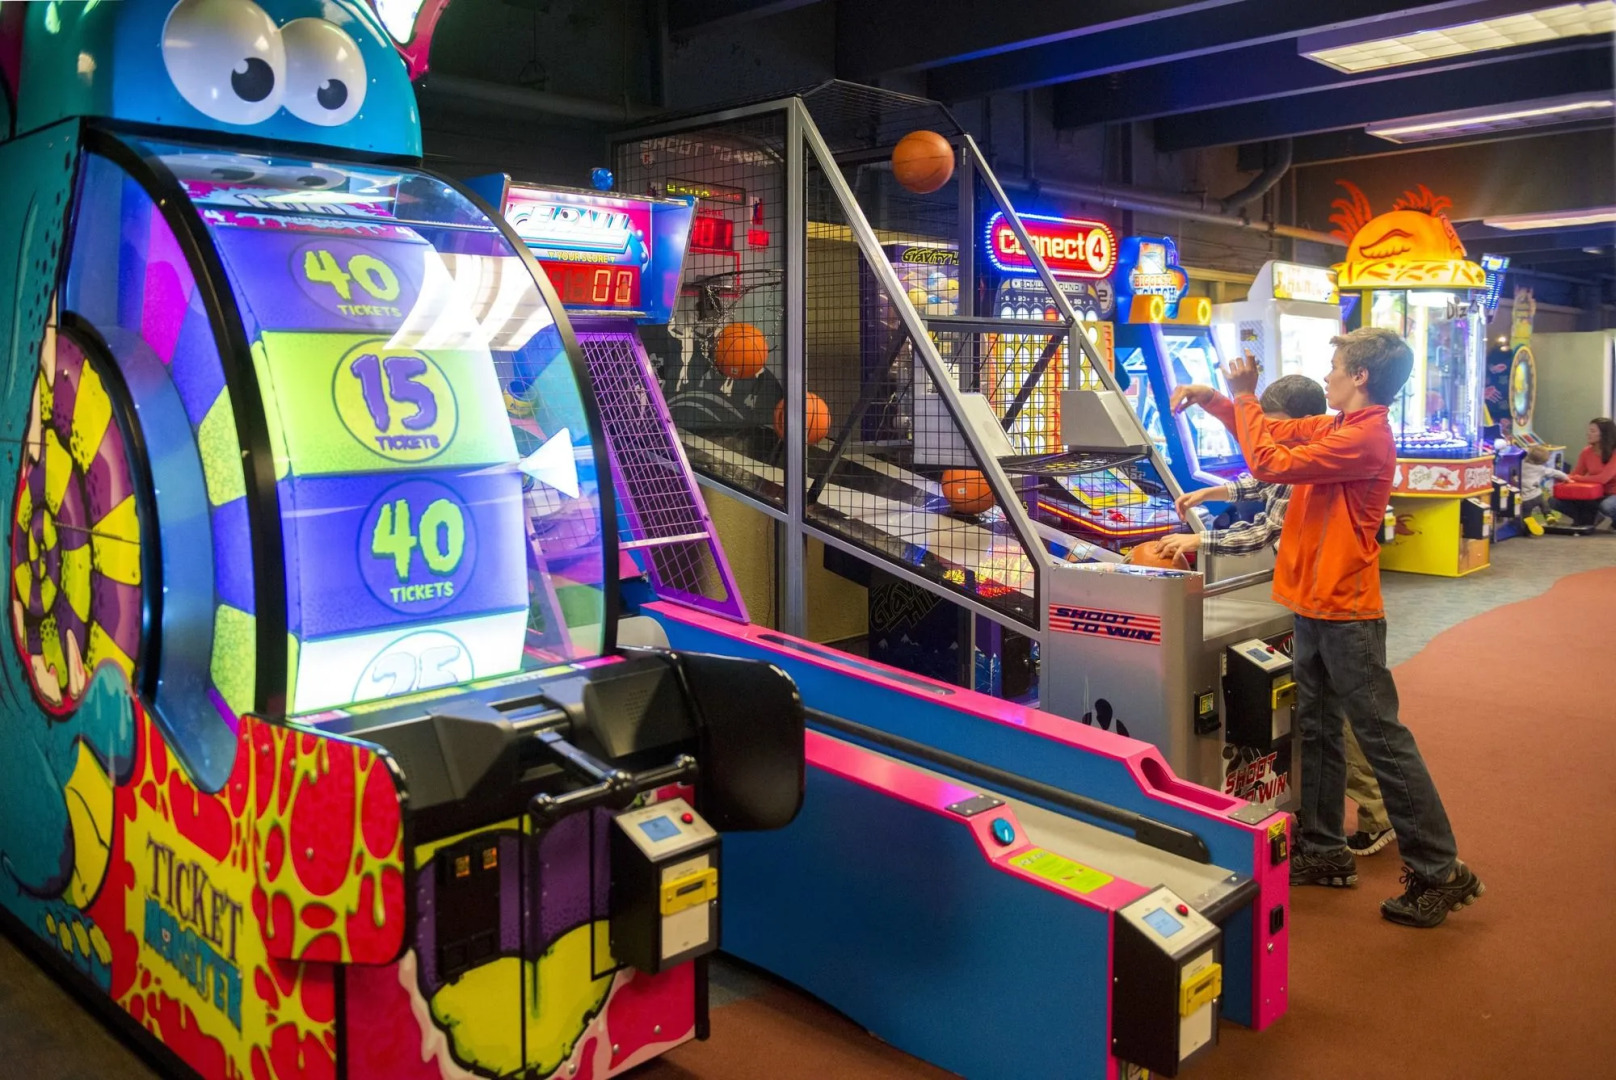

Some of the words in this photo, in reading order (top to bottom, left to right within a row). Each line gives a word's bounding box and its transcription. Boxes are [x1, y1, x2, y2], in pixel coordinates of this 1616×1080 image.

[557, 251, 582, 261] YOUR
[583, 252, 609, 264] SCORE
[998, 228, 1086, 261] Connect
[1092, 237, 1104, 262] 4
[304, 250, 401, 301] 40
[592, 269, 633, 303] 00
[336, 304, 403, 318] TICKETS
[349, 353, 438, 433] 15
[375, 434, 441, 451] TICKETS
[371, 498, 466, 581] 40
[389, 581, 455, 604] TICKETS
[1054, 607, 1136, 625] SHOOT
[1069, 620, 1100, 634] TO
[1105, 625, 1155, 641] WIN
[1224, 751, 1278, 795] SHOOT
[1257, 771, 1288, 805] WIN
[146, 831, 244, 964] TICKET
